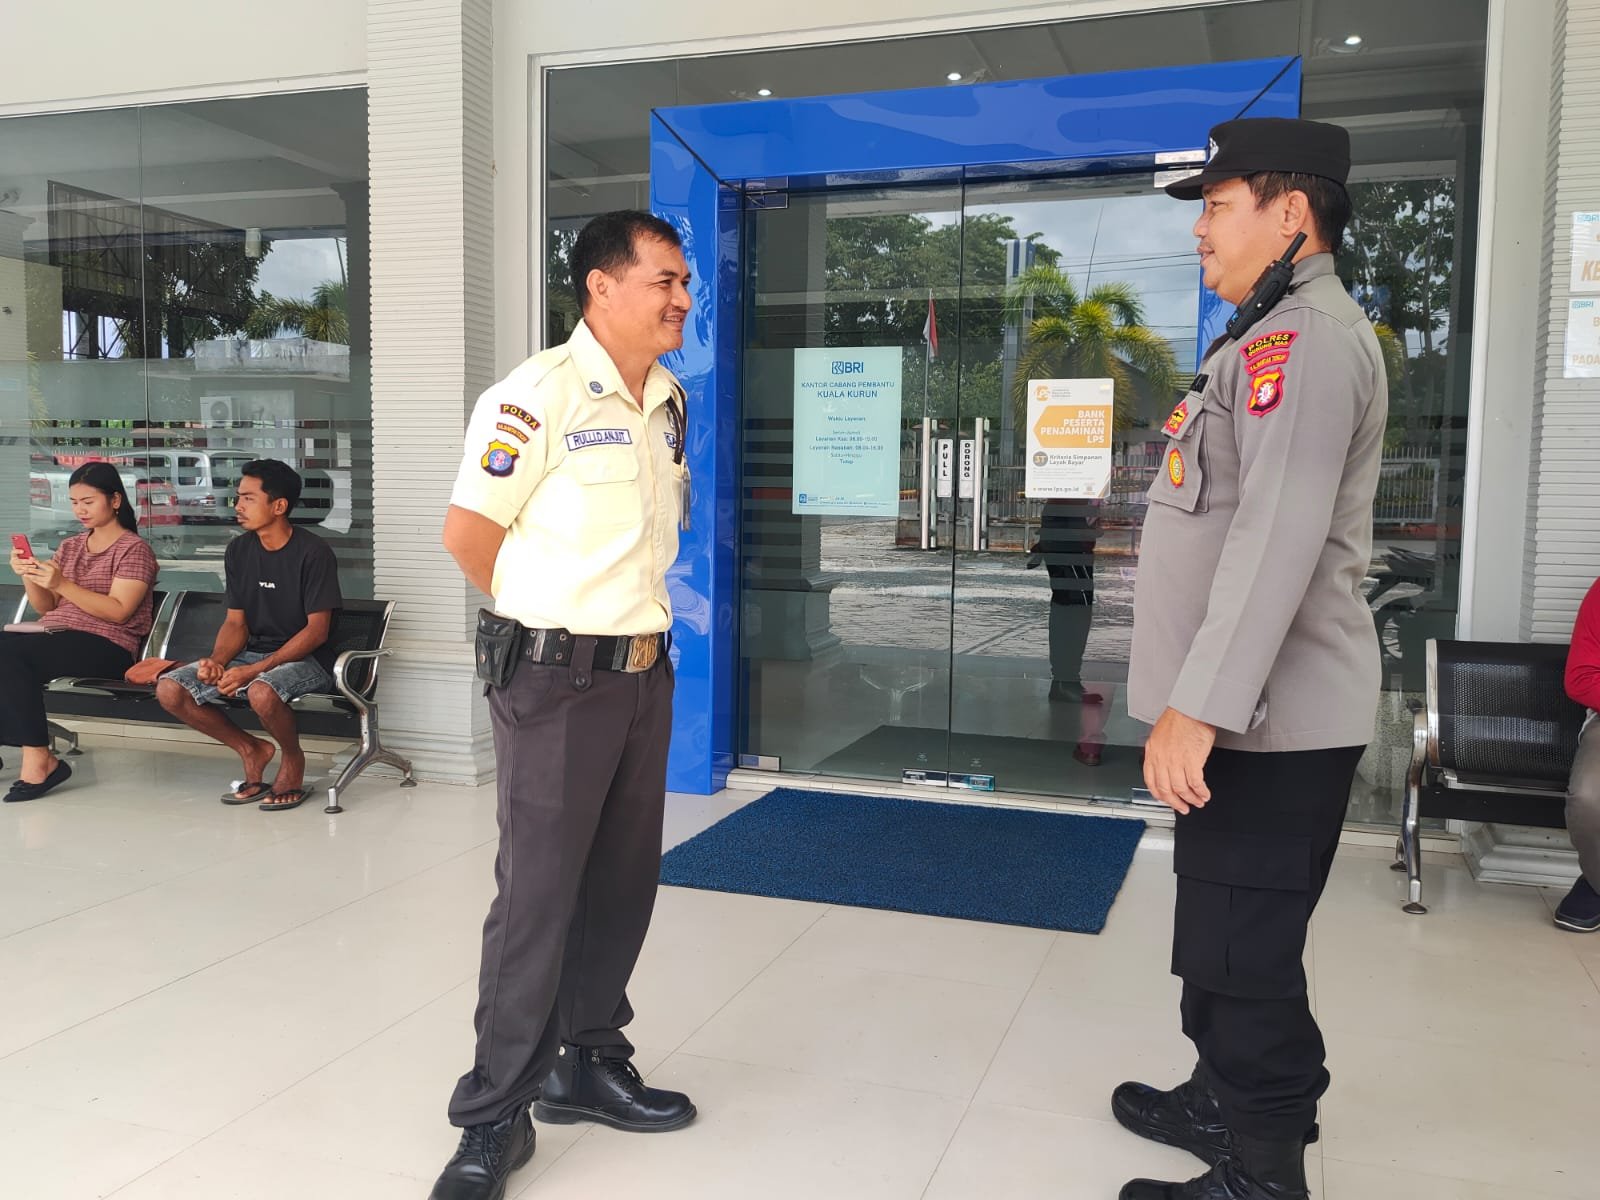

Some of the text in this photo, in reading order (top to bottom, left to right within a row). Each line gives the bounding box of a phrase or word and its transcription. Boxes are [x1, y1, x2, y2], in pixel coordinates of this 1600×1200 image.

[1248, 334, 1289, 351] POLRES
[845, 361, 864, 373] BRI
[817, 390, 878, 398] KUALA KURUN
[503, 405, 538, 429] POLDA
[1078, 410, 1105, 419] BANK
[1063, 418, 1105, 427] PESERTA
[1040, 427, 1105, 435] PENJAMINAN
[1087, 435, 1105, 443] LPS
[963, 442, 971, 478] DORONG
